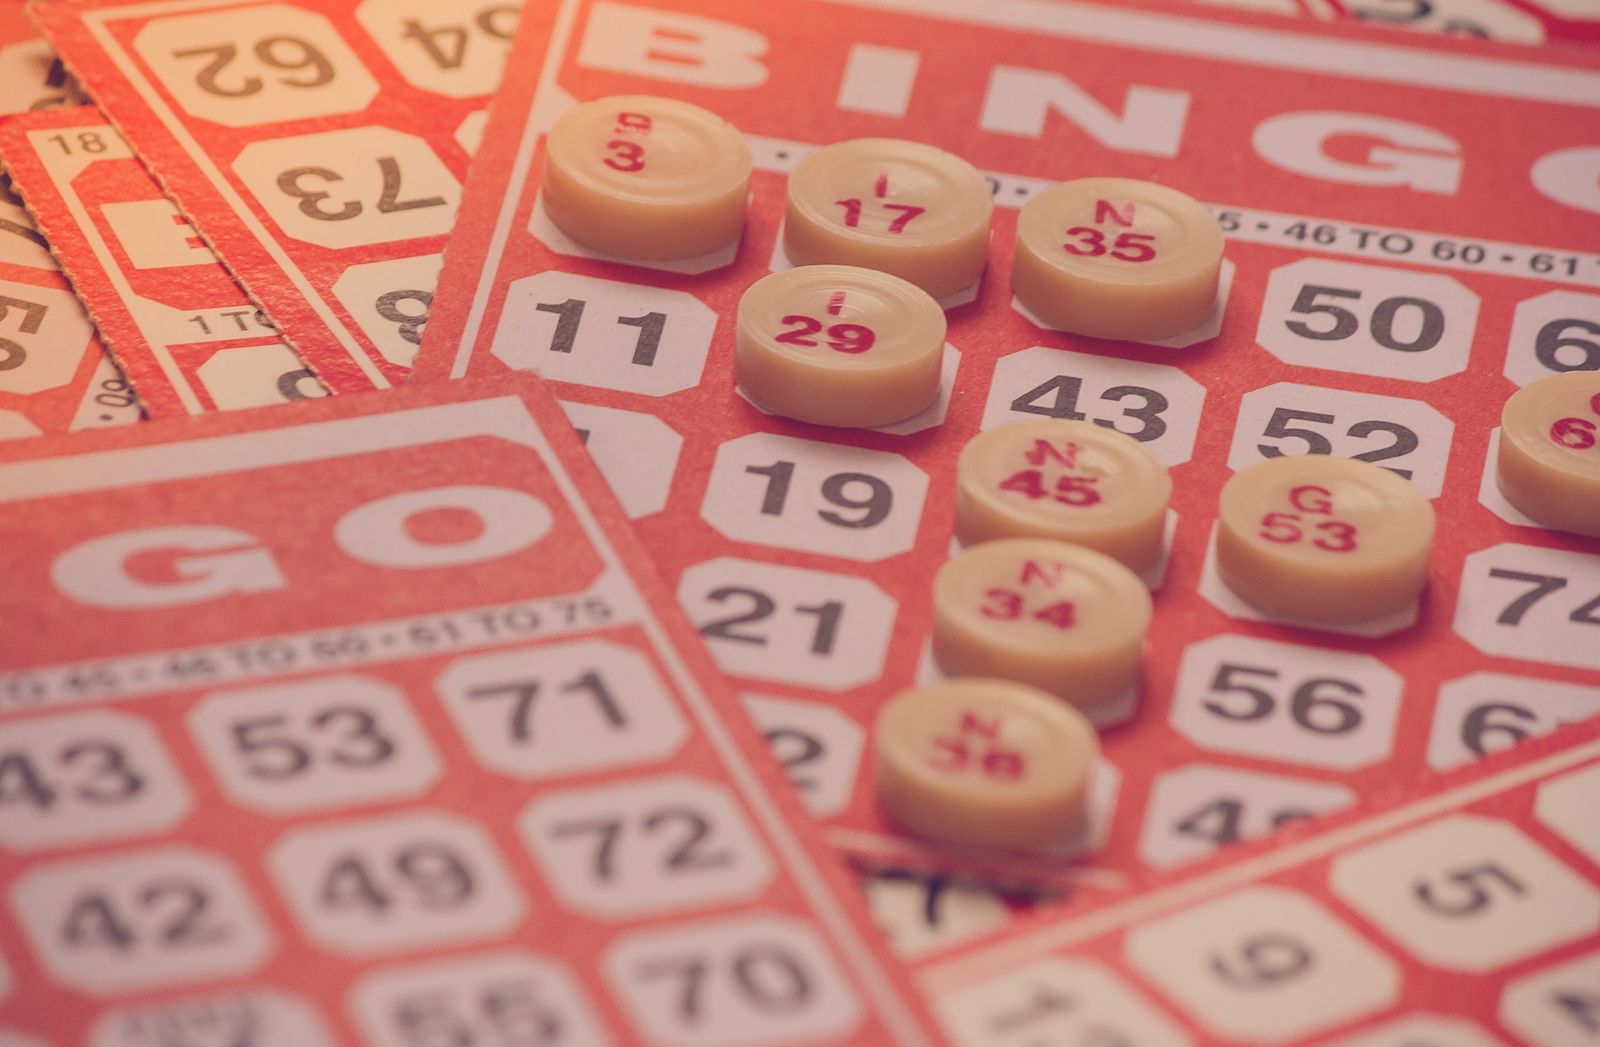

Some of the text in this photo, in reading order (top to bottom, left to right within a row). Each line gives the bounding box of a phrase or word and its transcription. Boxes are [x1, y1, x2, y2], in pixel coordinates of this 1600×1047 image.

[172, 36, 336, 98] 62
[47, 133, 108, 156] 18
[603, 140, 645, 173] 3
[275, 156, 448, 221] 73
[835, 198, 925, 234] 17
[1094, 199, 1136, 228] N
[1063, 226, 1157, 263] 35
[1284, 220, 1338, 245] 46
[1350, 227, 1415, 256] TO
[1431, 240, 1486, 266] 60
[1529, 252, 1579, 276] 61
[535, 298, 668, 367] 11
[774, 315, 877, 354] 29
[1284, 283, 1446, 353] 50
[1010, 375, 1169, 443] 43
[1024, 438, 1079, 469] N
[1257, 407, 1420, 482] 52
[745, 460, 893, 529] 19
[998, 469, 1102, 507] 45
[1289, 486, 1334, 516] G
[1258, 511, 1358, 554] 53
[1019, 559, 1065, 591] N
[700, 586, 845, 656] 21
[978, 587, 1077, 630] 34
[466, 671, 630, 746] 71
[1200, 661, 1366, 736] 56
[230, 706, 396, 780] 53
[1460, 702, 1570, 759] 6
[550, 806, 737, 882] 72
[1174, 797, 1316, 846] 4
[318, 843, 480, 920] 49
[60, 877, 236, 951] 42
[635, 942, 814, 1025] 70
